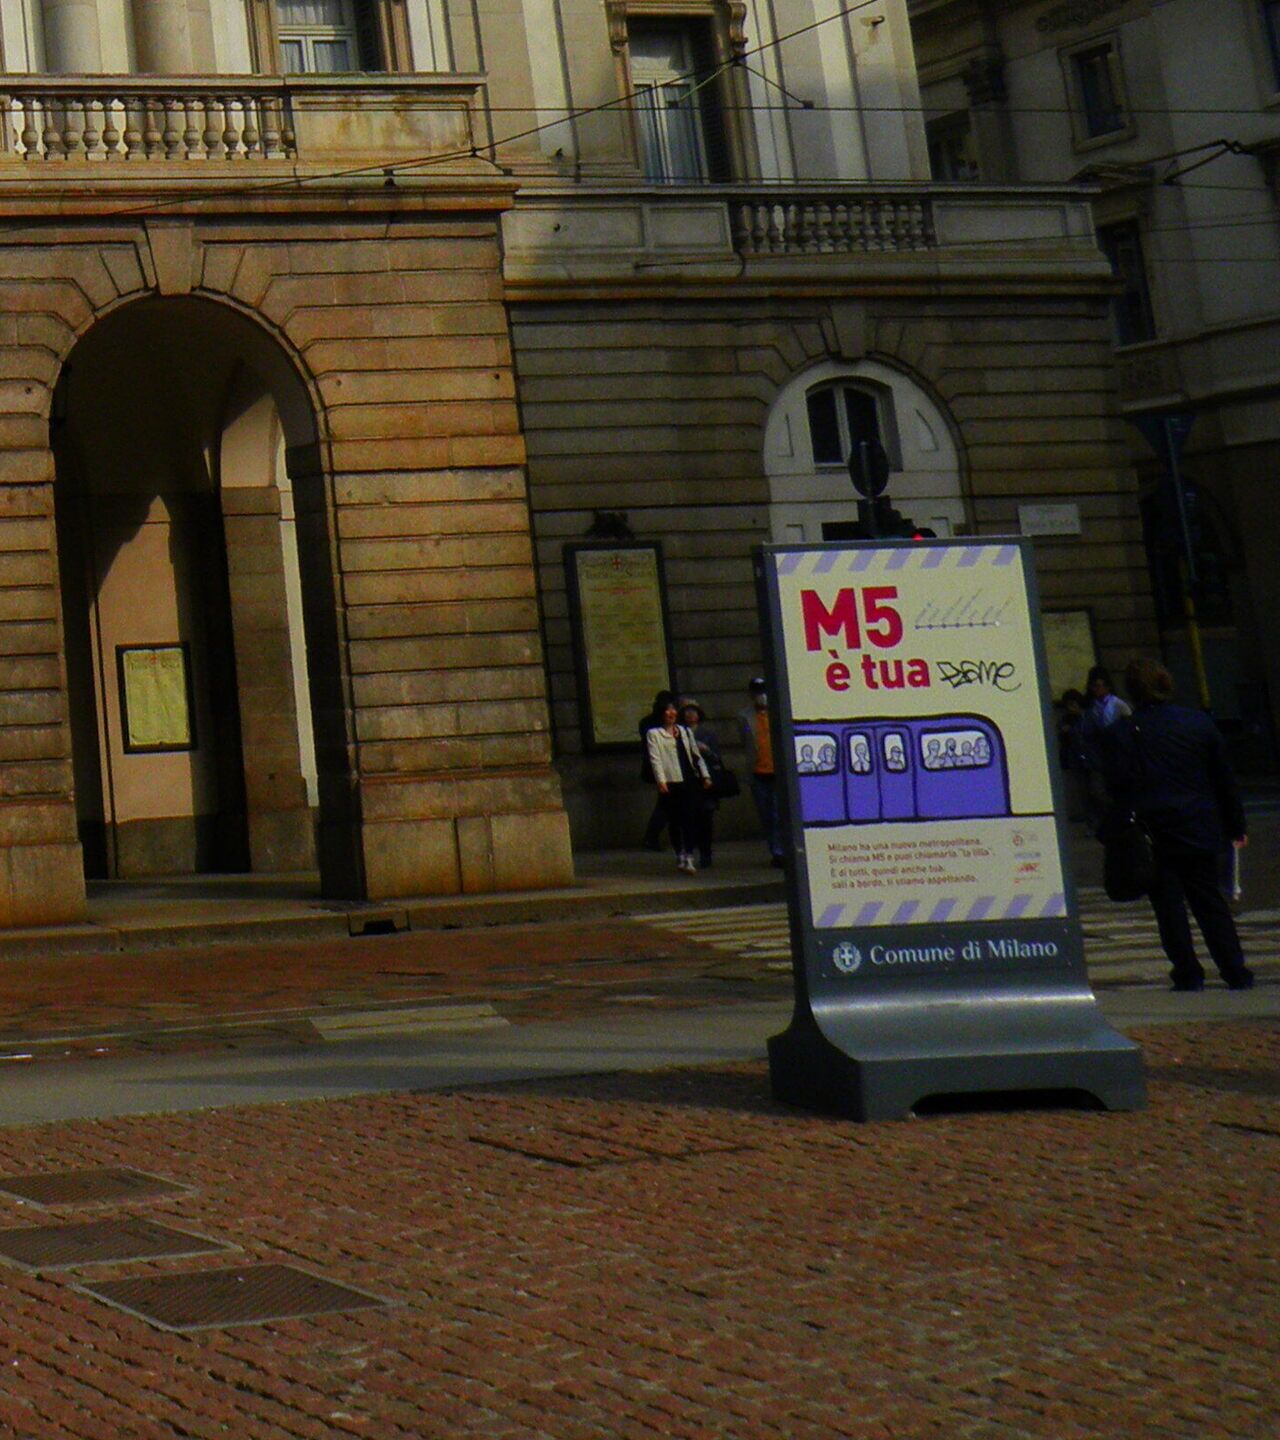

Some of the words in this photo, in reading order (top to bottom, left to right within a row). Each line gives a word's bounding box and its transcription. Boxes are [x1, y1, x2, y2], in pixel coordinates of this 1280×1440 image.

[800, 586, 903, 651] M5
[825, 649, 851, 692] è
[861, 654, 931, 690] tua
[828, 843, 857, 852] Milano
[859, 842, 871, 850] ha
[872, 841, 889, 850] una
[839, 854, 870, 863] chiama
[871, 866, 897, 877] quindi
[900, 865, 927, 874] anche
[895, 877, 925, 886] stiamo
[869, 945, 956, 965] Comune
[962, 941, 981, 960] di
[986, 938, 1058, 960] Milano
